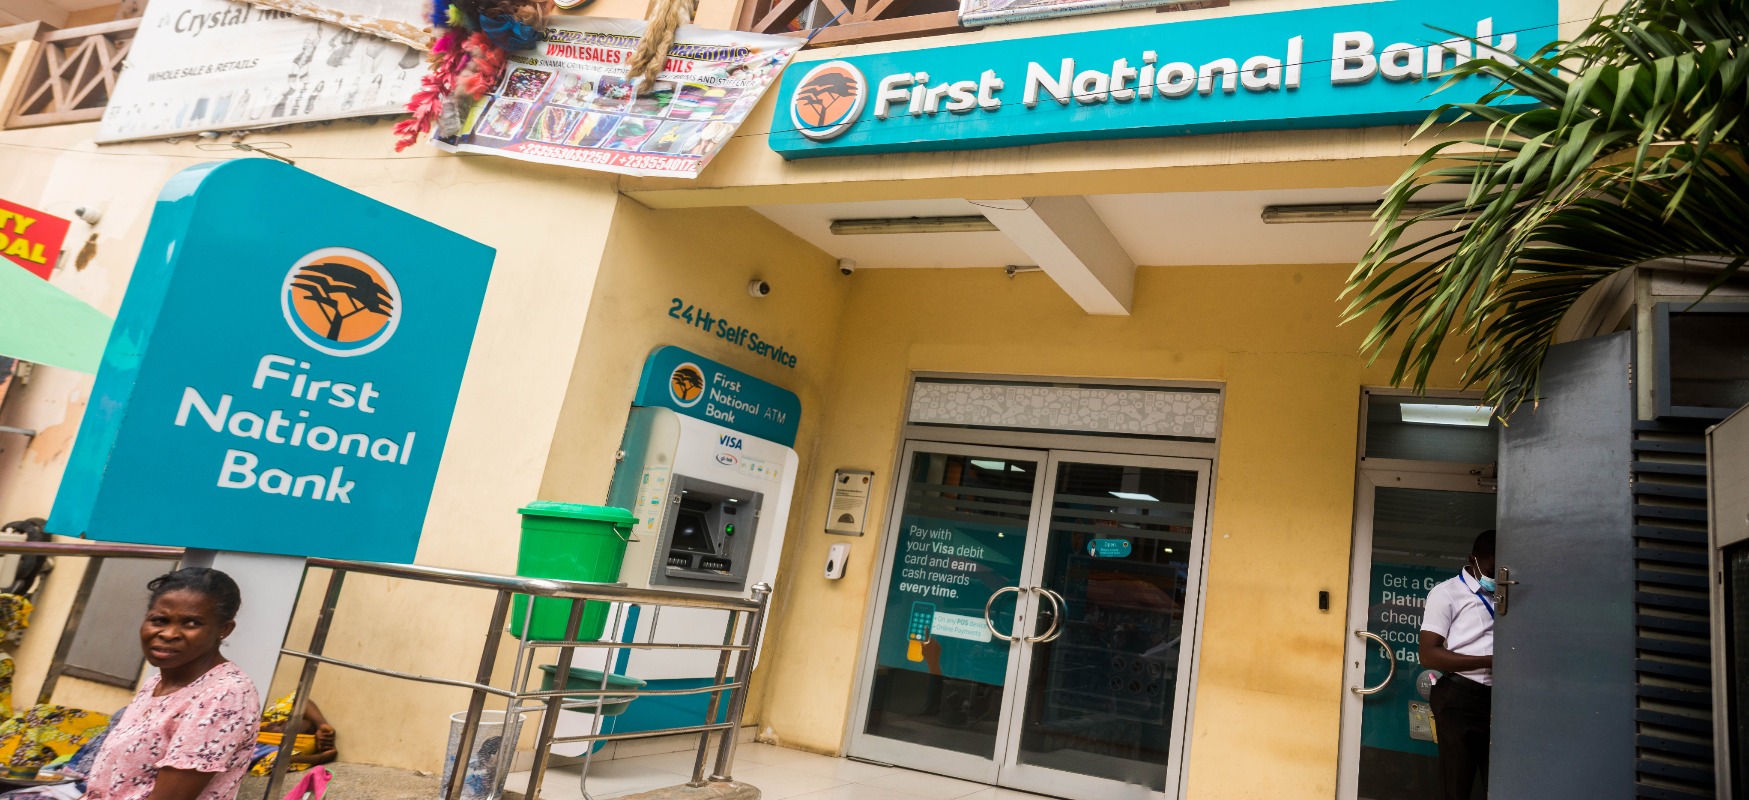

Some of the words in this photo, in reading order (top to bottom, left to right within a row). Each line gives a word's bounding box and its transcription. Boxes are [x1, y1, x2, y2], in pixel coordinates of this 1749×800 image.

[174, 3, 252, 37] Crystal
[546, 44, 620, 64] WHOLESALES
[667, 43, 750, 63] MATERIALS
[874, 69, 1004, 120] First
[1022, 35, 1303, 108] National
[1331, 16, 1517, 86] Bank
[698, 76, 715, 84] AND
[668, 297, 694, 325] 24
[694, 308, 716, 333] Hr
[716, 318, 749, 347] Self
[747, 332, 797, 369] Service
[252, 354, 380, 414] First
[713, 372, 741, 393] First
[705, 402, 735, 424] Bank
[709, 387, 760, 415] National
[764, 407, 786, 425] ATM
[174, 386, 416, 465] National
[719, 433, 743, 450] VISA
[216, 448, 355, 504] Bank
[909, 525, 928, 540] Pay
[929, 528, 952, 541] with
[906, 540, 931, 552] your
[932, 541, 954, 555] Visa
[956, 545, 984, 559] debit
[904, 554, 928, 566] card
[929, 557, 949, 569] and
[951, 560, 977, 572] earn
[902, 567, 926, 580] cash
[928, 571, 970, 586] rewards
[1383, 573, 1408, 589] Get
[1411, 578, 1420, 590] a
[899, 581, 930, 597] every
[931, 584, 959, 599] time.
[1382, 590, 1426, 608] Platin
[936, 624, 954, 632] Online
[954, 626, 981, 637] Payments
[957, 618, 969, 626] POS
